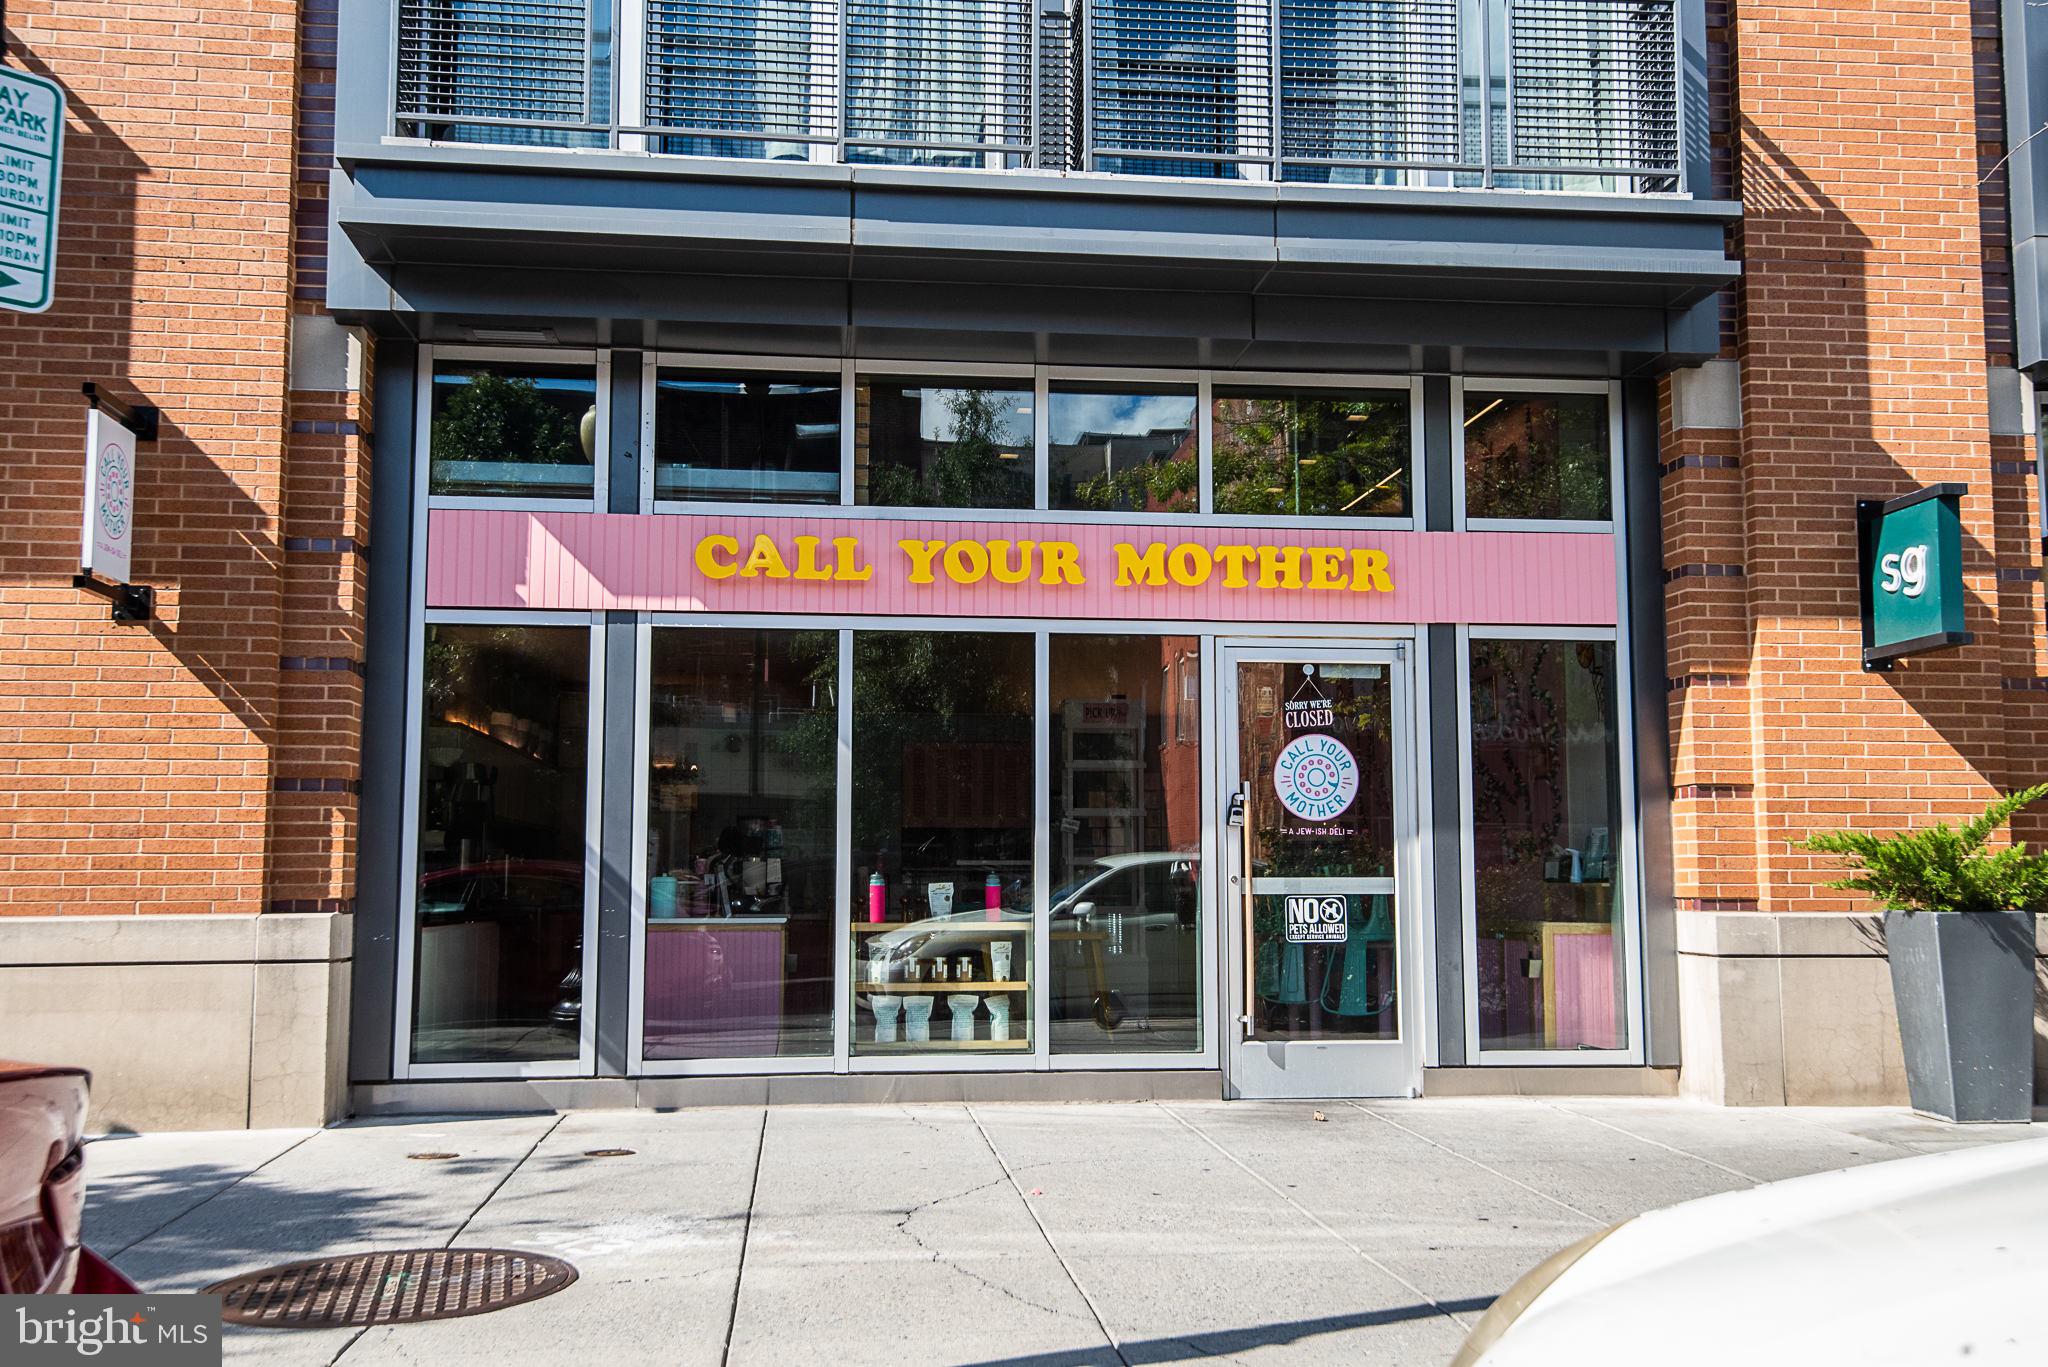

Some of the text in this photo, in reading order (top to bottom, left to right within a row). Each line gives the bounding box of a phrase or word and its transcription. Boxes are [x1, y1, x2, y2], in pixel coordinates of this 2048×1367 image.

[0, 155, 35, 171] IMIT
[694, 534, 1395, 593] CALL YOUR MOTHER
[1881, 544, 1928, 597] sg
[1285, 699, 1333, 711] SORRY WE'RE
[1285, 709, 1333, 728] CLOSED
[1280, 739, 1352, 771] CALL YOUR
[1285, 791, 1346, 817] MOTHER
[1288, 827, 1345, 835] A JEW-ISH DELI
[1288, 898, 1319, 924] NO
[1289, 923, 1345, 935] PETS ALLOWED
